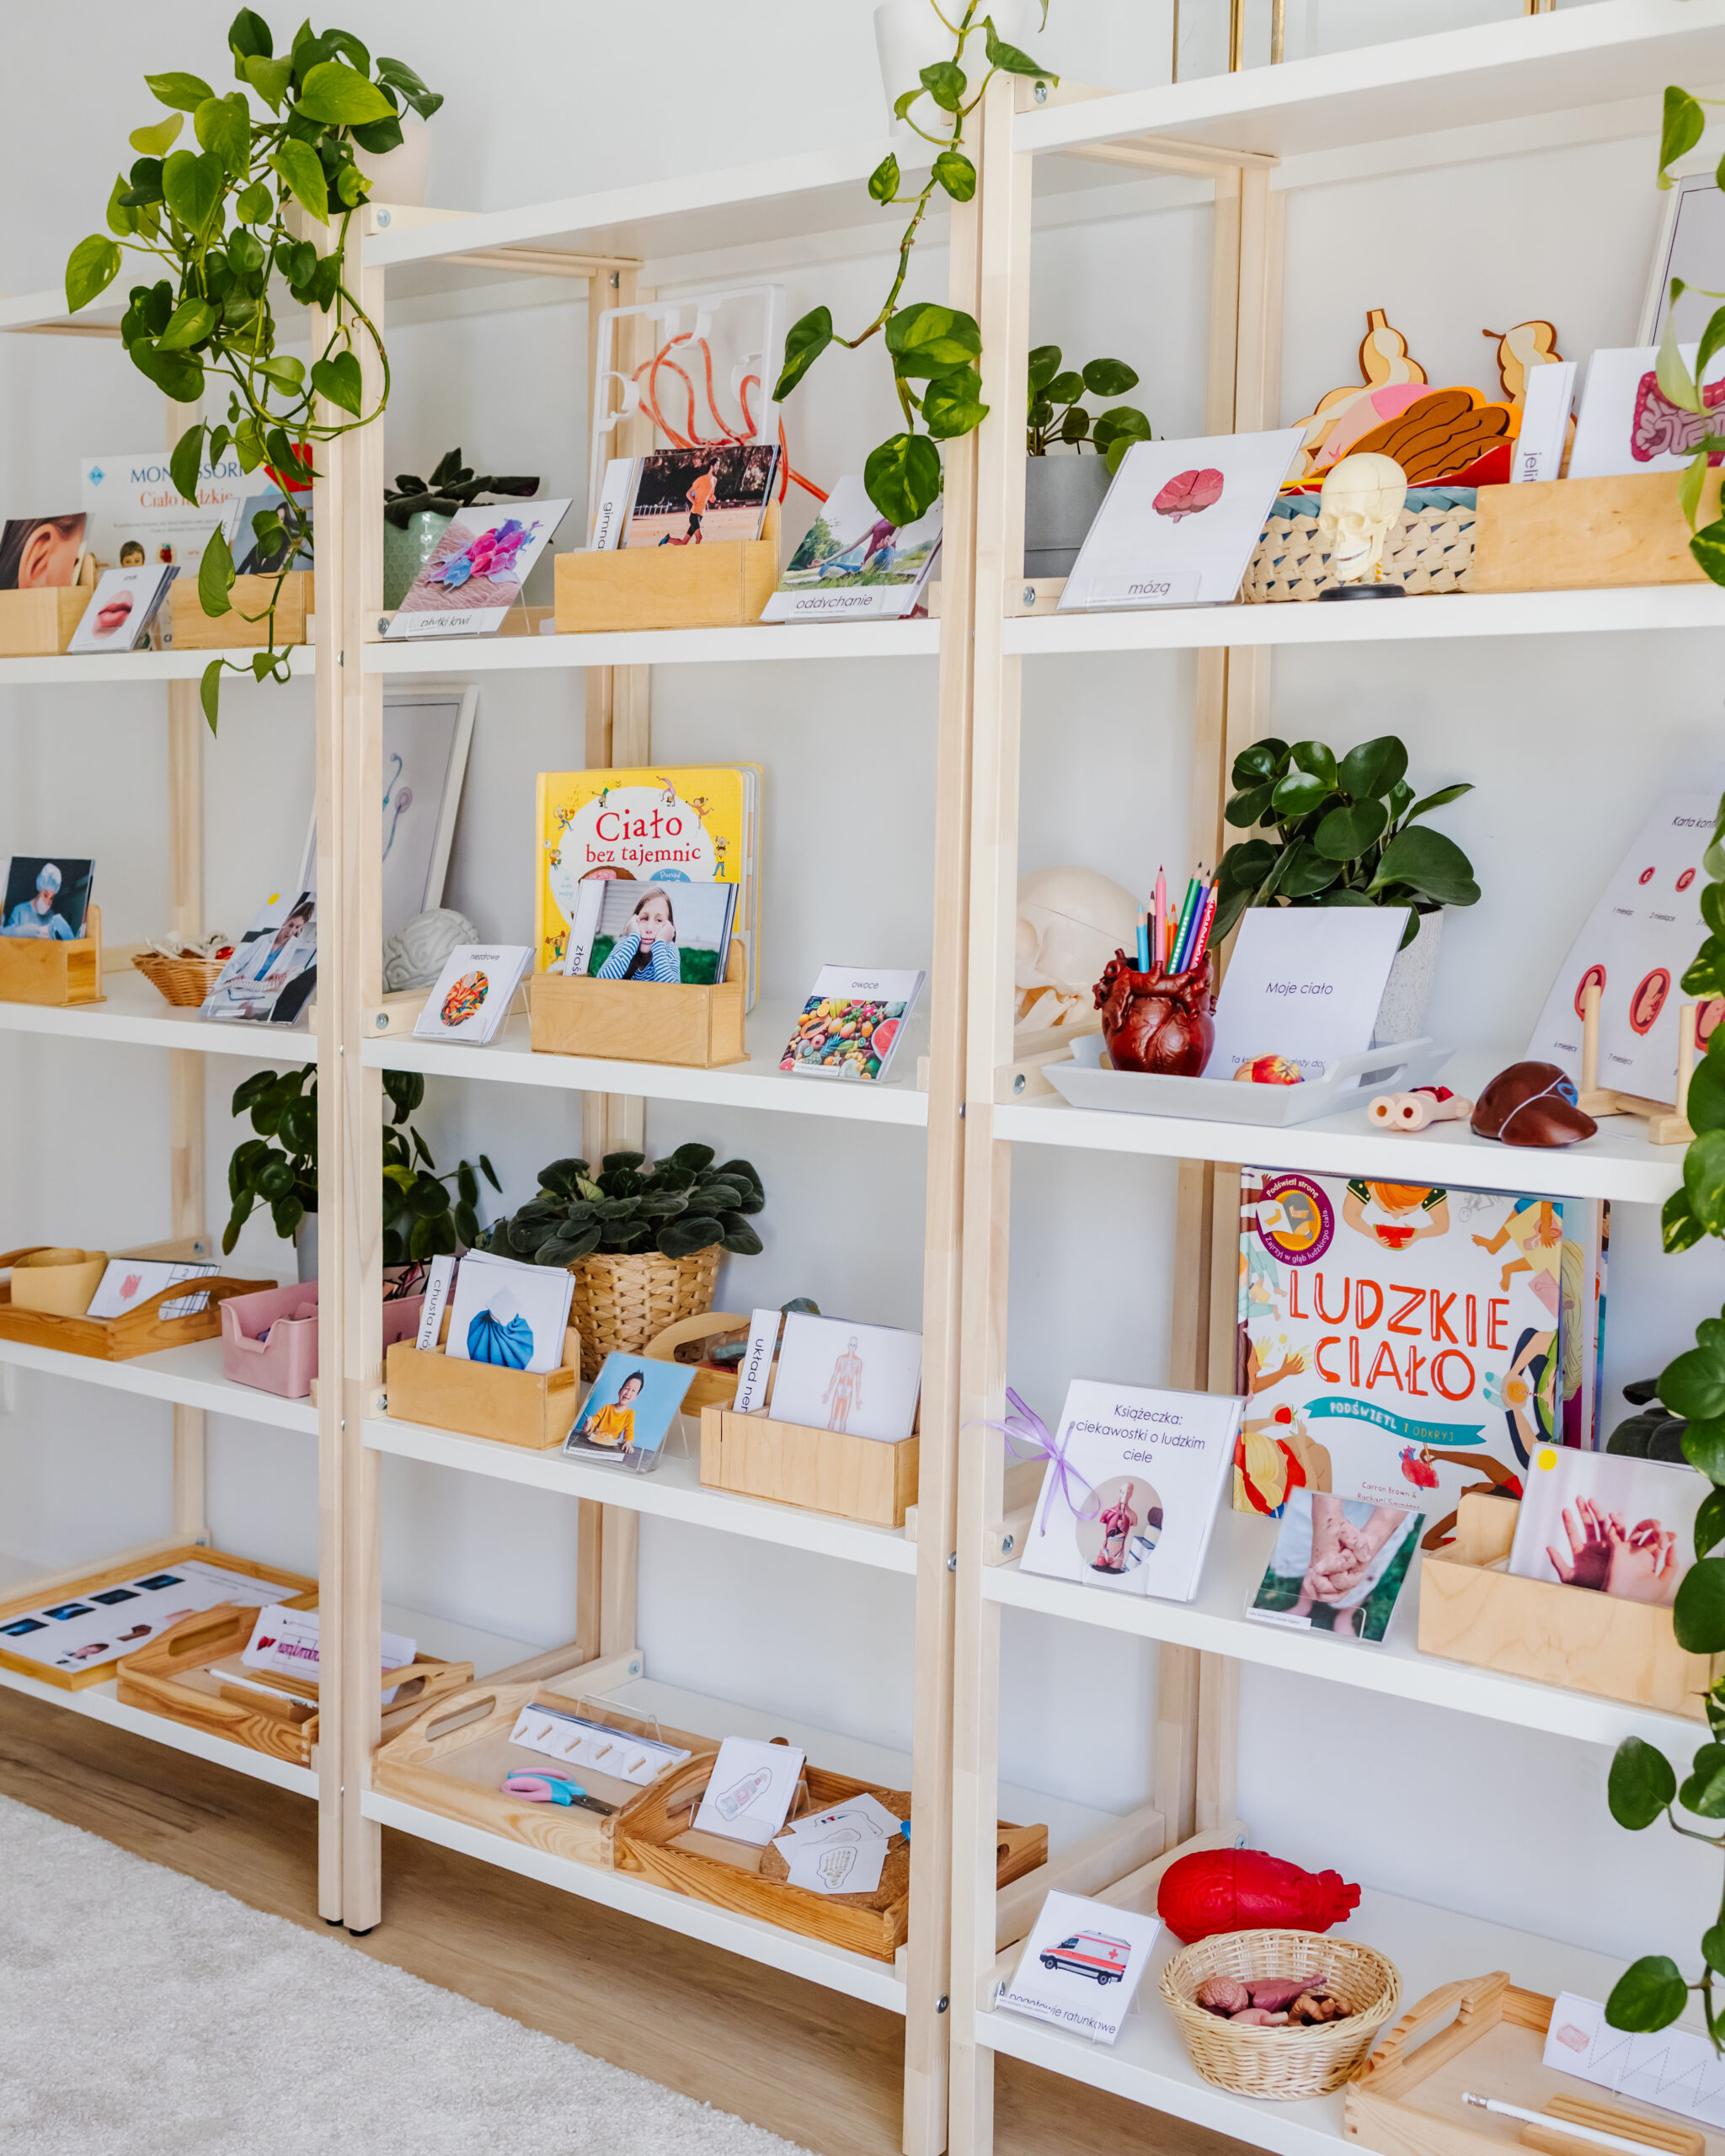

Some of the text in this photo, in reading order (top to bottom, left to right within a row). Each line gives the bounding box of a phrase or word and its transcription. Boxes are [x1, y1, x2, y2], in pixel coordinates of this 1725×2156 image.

[131, 462, 243, 484] MONSORI
[596, 501, 614, 551] gimna
[1127, 579, 1172, 596] mózg
[796, 594, 873, 610] oddychanie
[595, 808, 683, 842] Ciało
[1671, 815, 1696, 828] Karta
[585, 842, 702, 867] bez tajemnic
[851, 981, 879, 990] owoce
[1265, 981, 1333, 996] Moje ciało
[1231, 1054, 1242, 1065] Ta
[1298, 1180, 1320, 1199] stronę
[1307, 1230, 1330, 1260] ludzkiego
[181, 1267, 190, 1278] 2
[419, 1279, 442, 1351] chusta tró
[1290, 1269, 1510, 1351] LUDZKIE
[747, 1338, 765, 1383] układ
[1314, 1336, 1476, 1401] CIAŁO
[1114, 1404, 1183, 1426] Książeczka:
[1329, 1401, 1397, 1430] PODŚWIETL
[1412, 1426, 1455, 1443] ODKRYJ
[1076, 1419, 1206, 1450] ciekawostki o ludzkim
[1123, 1449, 1153, 1464] ciele
[1387, 1486, 1410, 1497] Brown
[1062, 2009, 1117, 2035] ratunkowe
